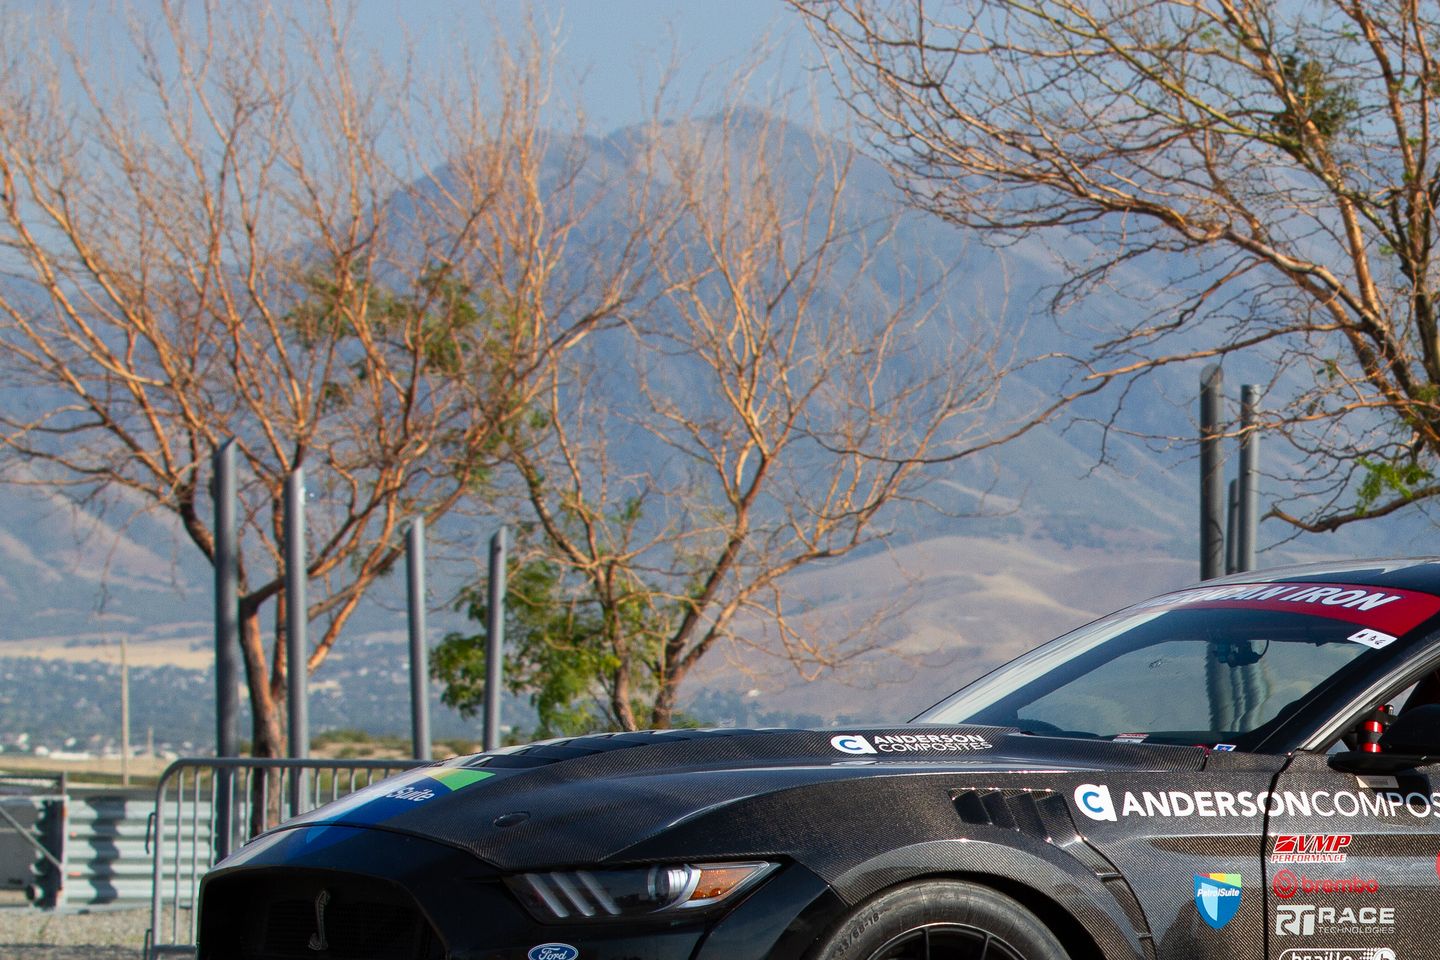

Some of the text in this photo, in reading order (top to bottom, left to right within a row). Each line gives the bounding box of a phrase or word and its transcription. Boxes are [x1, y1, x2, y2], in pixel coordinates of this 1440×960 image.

[1284, 586, 1404, 612] IRON
[874, 735, 985, 745] ANDERSON
[879, 742, 993, 752] COMPOSITES
[1297, 835, 1352, 853] VMP
[1271, 853, 1347, 864] PERFORMANCE
[1301, 873, 1379, 894] brembo
[1318, 907, 1395, 924] RACE
[1319, 926, 1395, 934] TECHNOLOGIES
